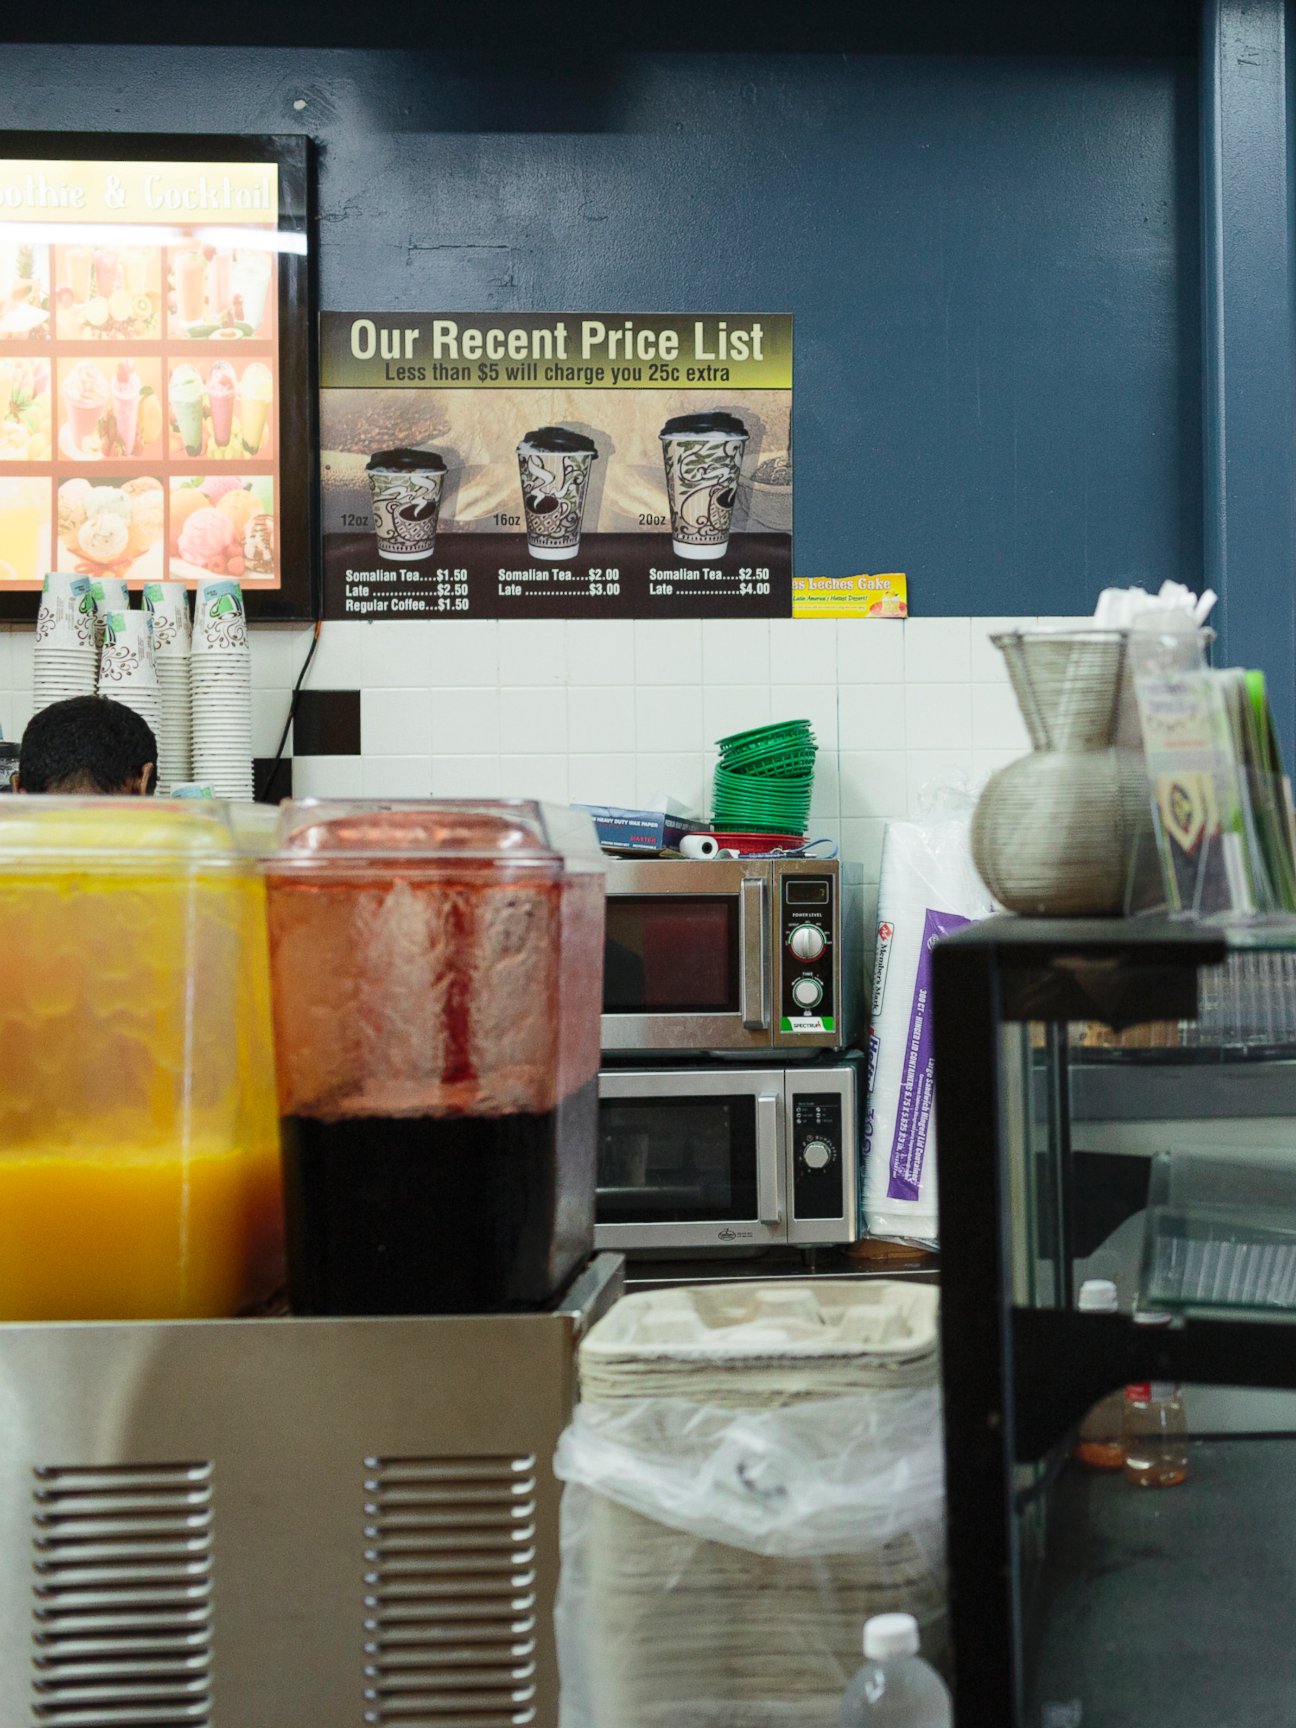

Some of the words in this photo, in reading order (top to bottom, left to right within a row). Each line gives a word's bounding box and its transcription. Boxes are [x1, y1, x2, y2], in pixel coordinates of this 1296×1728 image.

[0, 173, 86, 210] othie
[104, 174, 126, 210] &
[143, 175, 270, 210] Cocktail
[351, 319, 420, 360] Our
[433, 320, 567, 360] Recent
[582, 321, 679, 361] Price
[695, 322, 764, 361] List
[385, 363, 426, 381] Less
[432, 363, 471, 381] than
[478, 362, 499, 383] $5
[506, 363, 538, 381] will
[545, 363, 605, 385] charge
[611, 367, 642, 385] you
[649, 363, 680, 382] 25c
[686, 366, 730, 382] extra
[341, 514, 369, 527] 12oz
[494, 514, 521, 526] 16oz
[639, 514, 667, 526] 20oz
[345, 569, 397, 582] Somalian
[498, 568, 550, 581] Somalian
[649, 568, 700, 580] Somalian
[498, 583, 522, 596] Late
[649, 582, 673, 595] Late
[808, 578, 854, 590] Leches
[858, 578, 891, 590] Cake
[345, 585, 369, 597] Late
[345, 599, 389, 613] Regular
[871, 985, 881, 1009] Mark
[918, 988, 928, 1003] 300
[912, 1015, 923, 1040] HINGED
[911, 1040, 919, 1052] LID
[905, 1052, 918, 1094] CONTAINERS
[921, 1078, 934, 1112] Sandwich
[918, 1110, 929, 1134] Hinged
